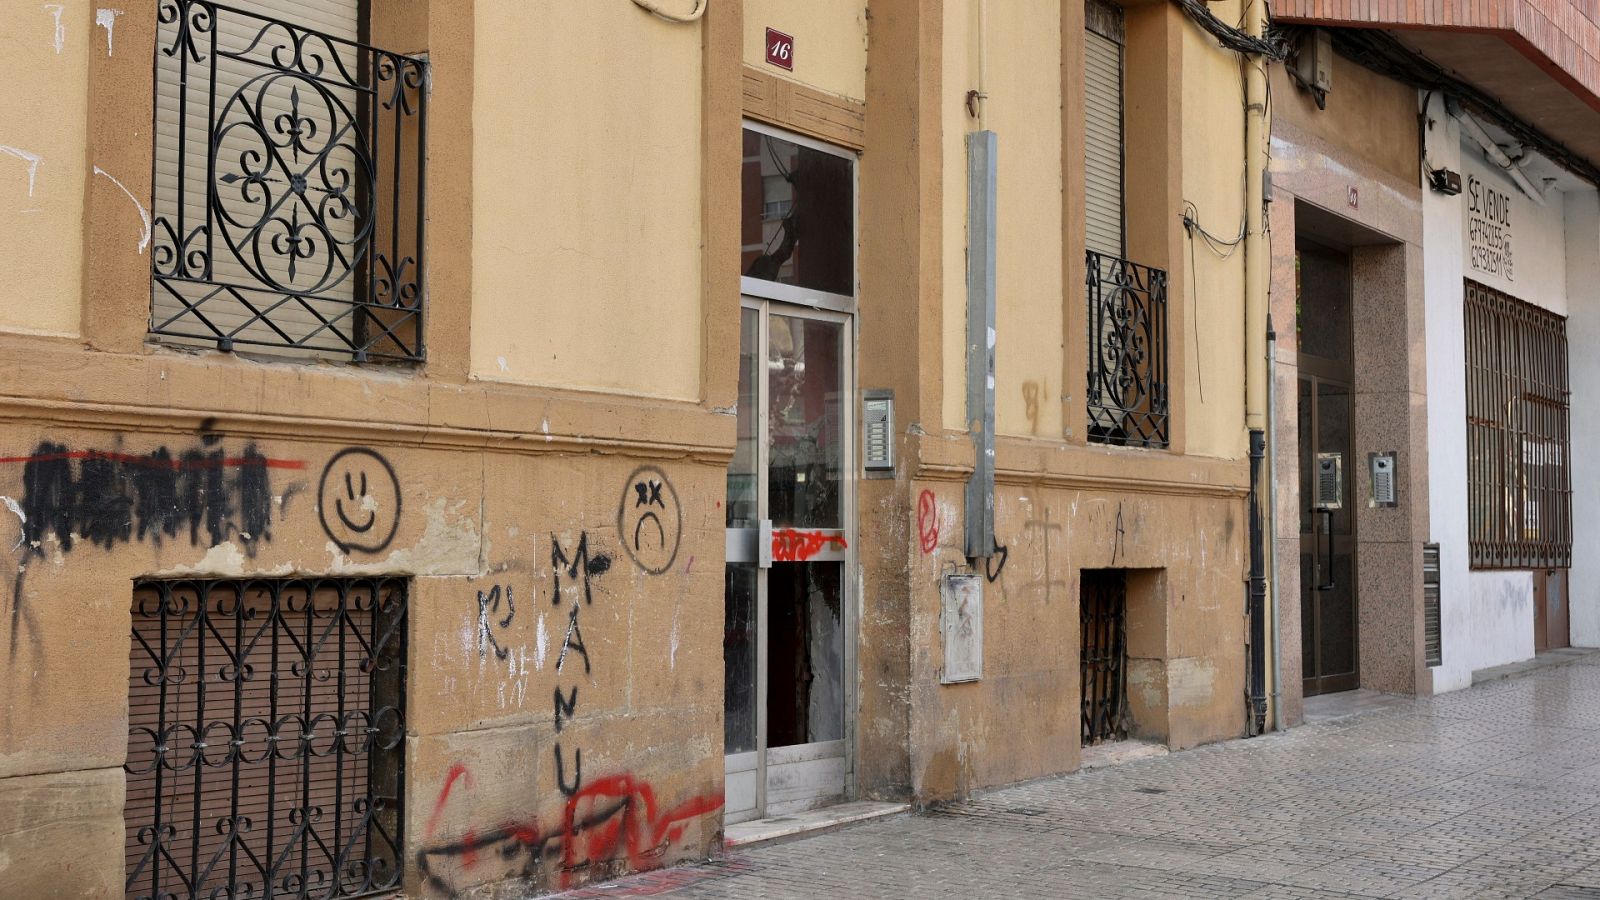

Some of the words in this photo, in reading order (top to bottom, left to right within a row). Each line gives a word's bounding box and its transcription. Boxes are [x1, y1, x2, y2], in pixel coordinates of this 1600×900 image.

[771, 40, 791, 60] 16
[1468, 178, 1481, 213] SE
[1482, 185, 1511, 228] VENDE
[550, 531, 593, 797] MANU
